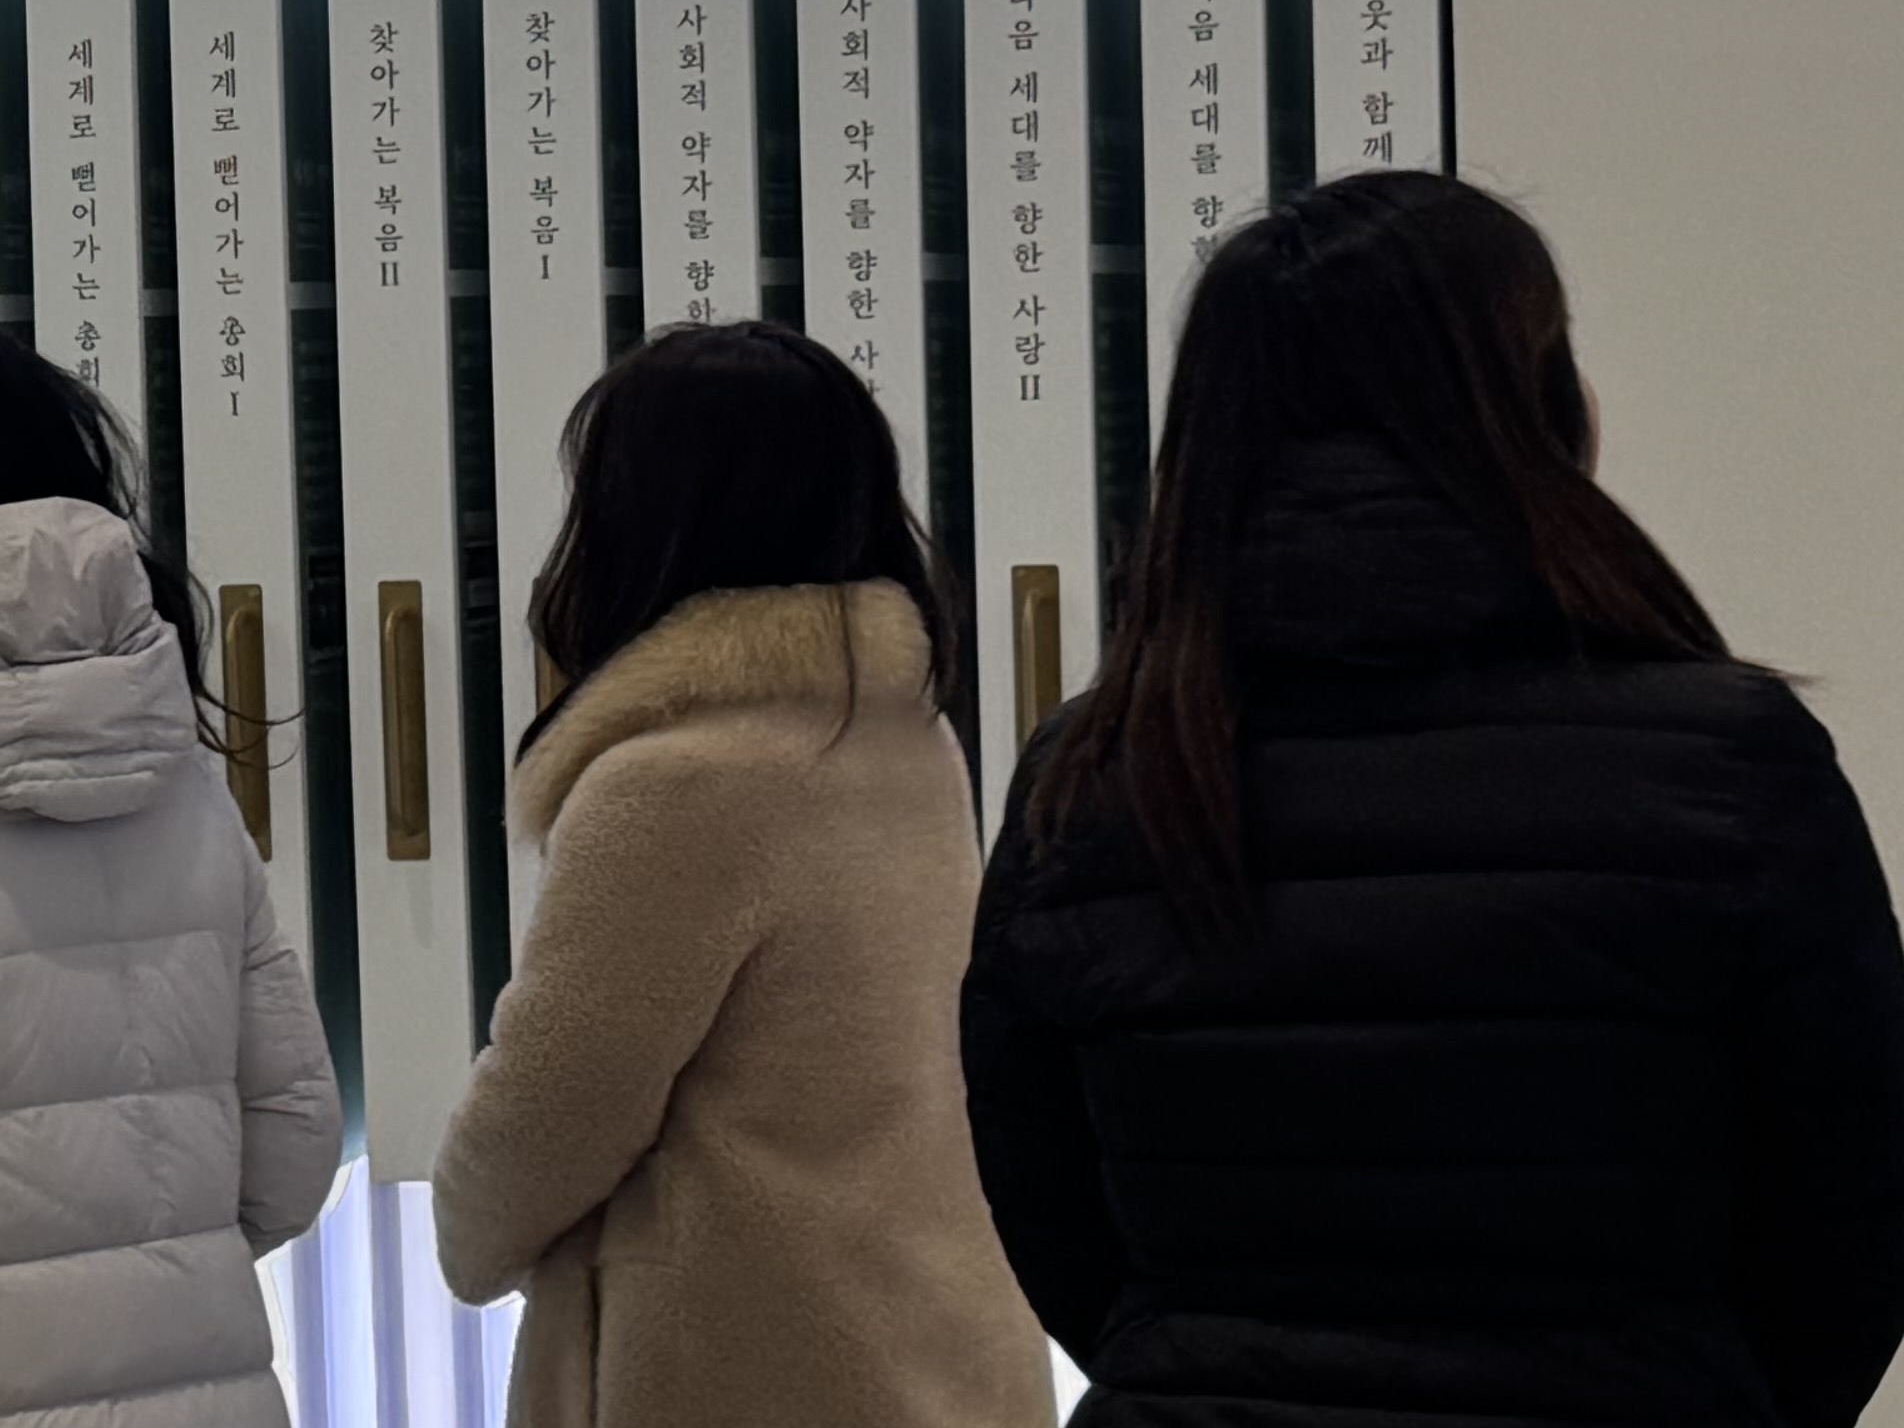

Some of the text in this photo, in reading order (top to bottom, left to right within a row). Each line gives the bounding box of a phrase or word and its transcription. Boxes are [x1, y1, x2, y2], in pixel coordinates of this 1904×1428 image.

[69, 38, 95, 140] 세계로
[209, 31, 240, 134] 세계로
[369, 21, 401, 165] 찾아가는
[525, 11, 556, 156] 찾아가는
[677, 4, 708, 112] 사회적
[1010, 70, 1042, 183] 세대를
[1189, 61, 1221, 176] 세대를
[1362, 91, 1393, 164] 함께
[681, 132, 713, 241] 약자를
[844, 119, 875, 230] 약자를
[846, 249, 879, 320] 향한
[1012, 202, 1044, 274] 향한
